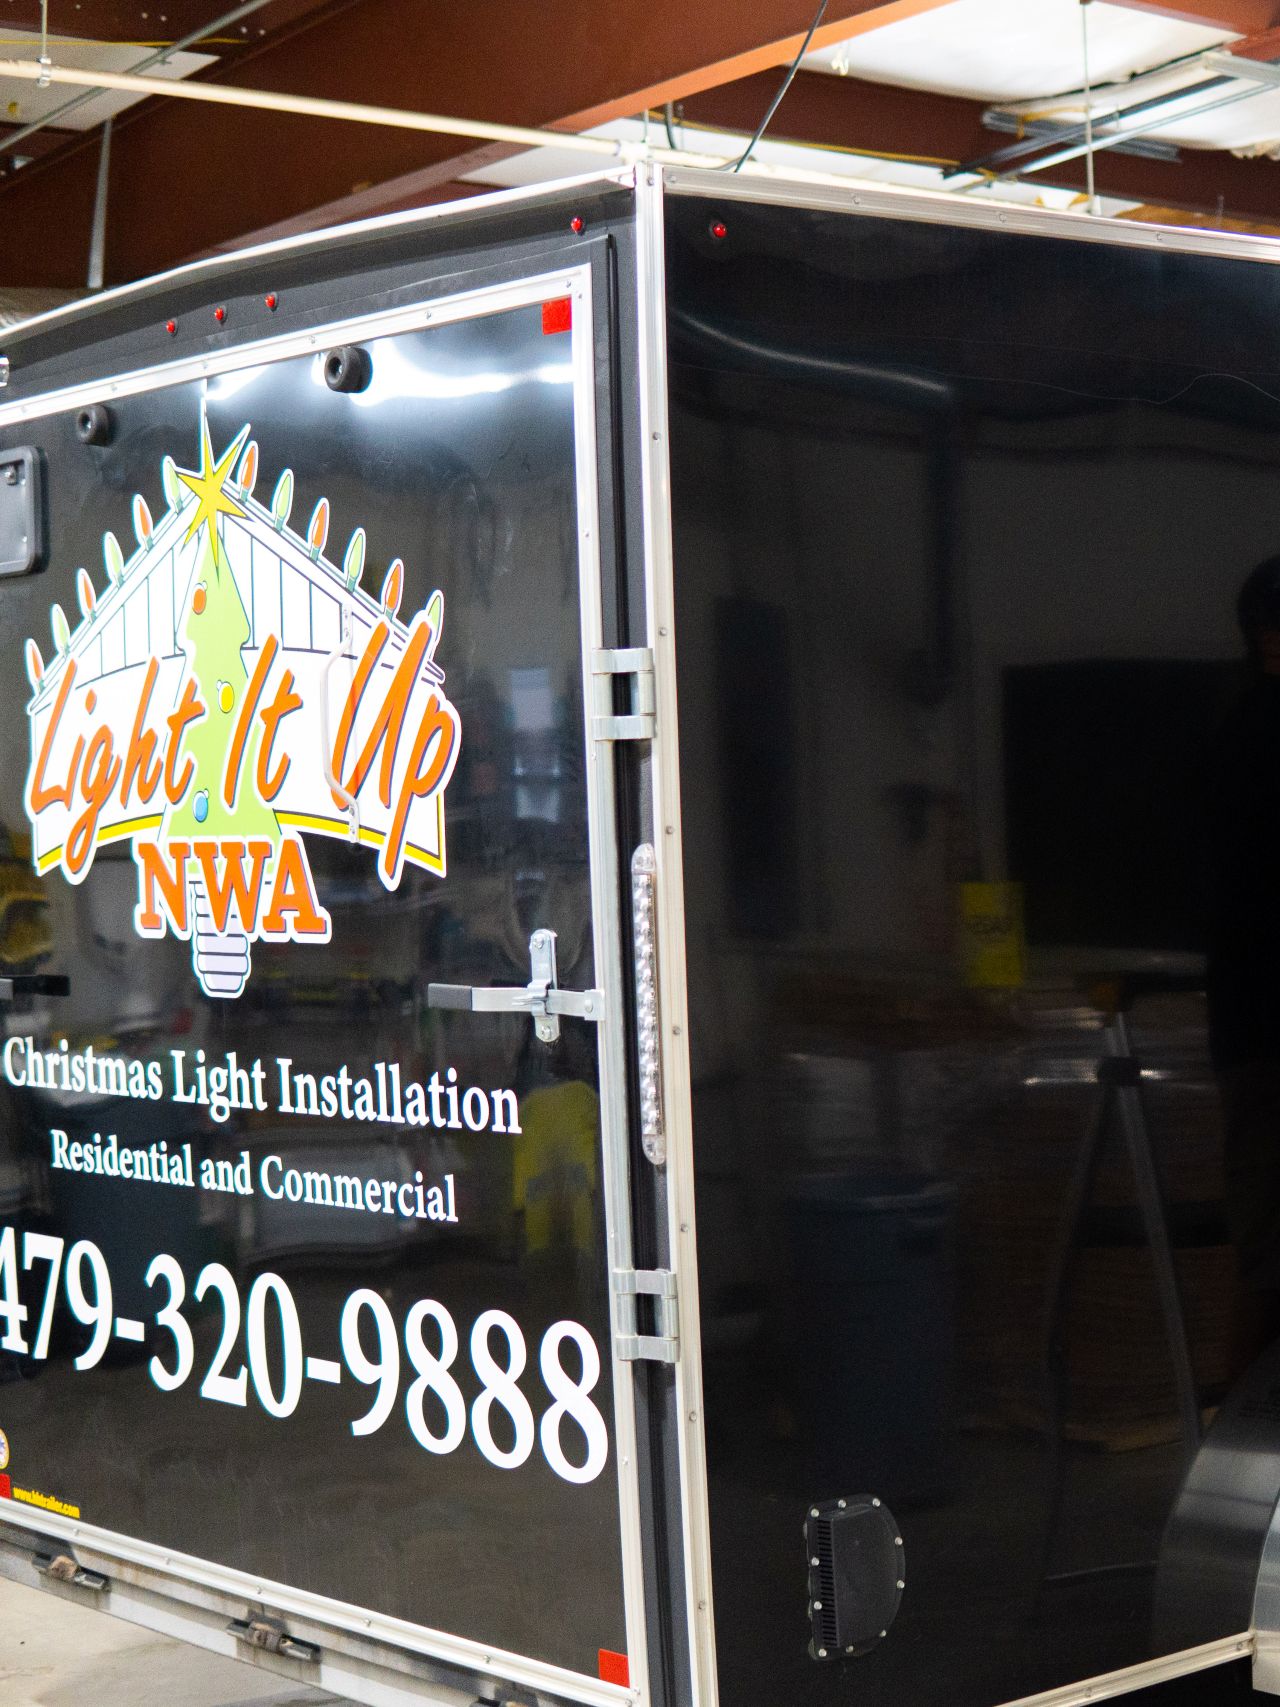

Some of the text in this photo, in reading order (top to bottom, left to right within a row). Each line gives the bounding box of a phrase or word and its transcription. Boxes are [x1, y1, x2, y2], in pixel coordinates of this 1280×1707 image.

[30, 618, 457, 878] Light It Up
[137, 838, 327, 935] NWA
[3, 1035, 523, 1134] Christmas Light Installation
[50, 1128, 459, 1223] Residential and Commercial
[0, 1226, 609, 1485] 479-320-9888
